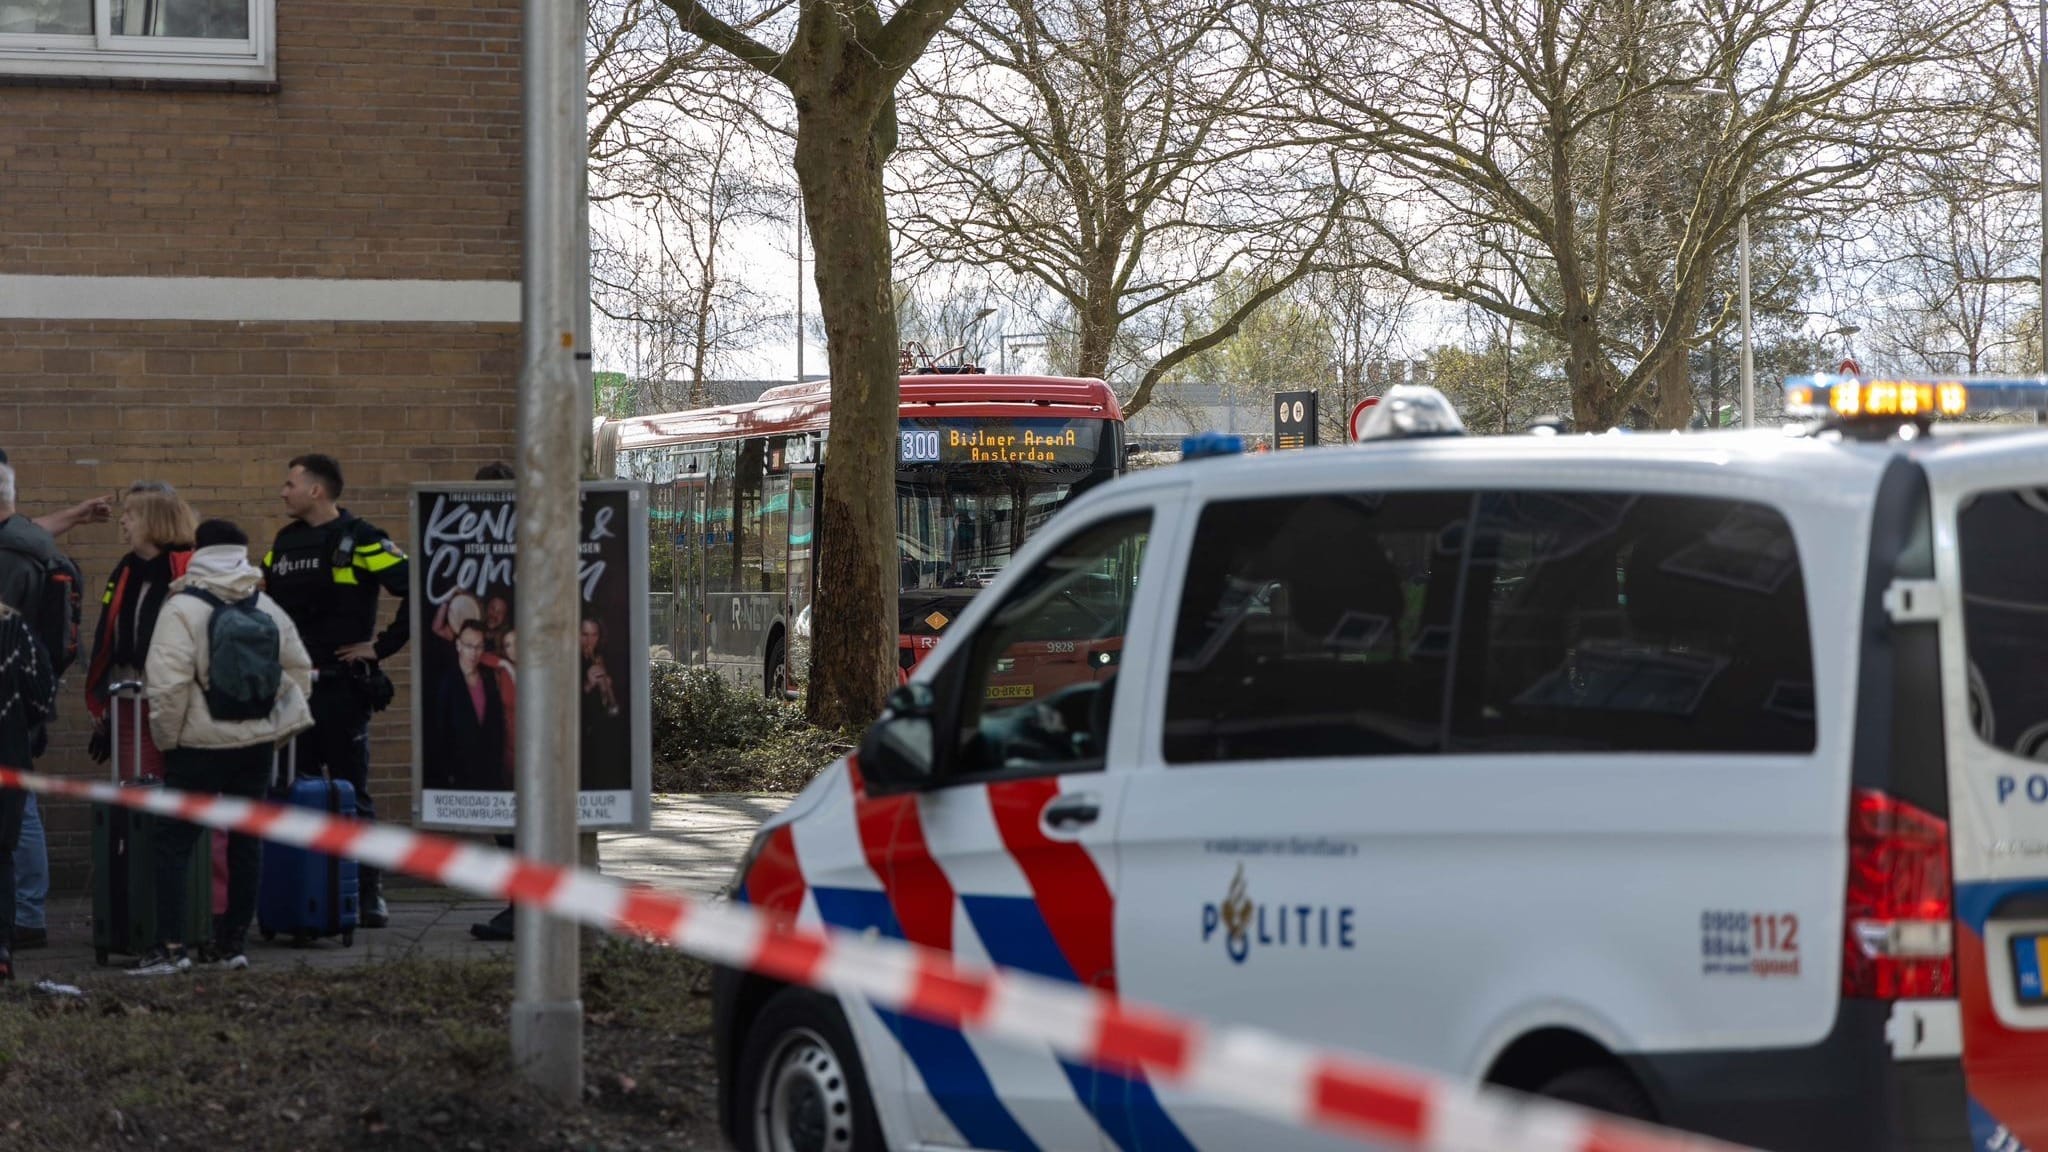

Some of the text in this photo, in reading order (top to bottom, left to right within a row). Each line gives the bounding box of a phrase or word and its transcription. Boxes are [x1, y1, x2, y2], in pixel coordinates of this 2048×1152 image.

[902, 431, 940, 460] 300
[950, 429, 1075, 448] Bijlmer ArenA
[972, 448, 1055, 462] Amsterdam
[589, 506, 616, 540] &
[272, 556, 320, 576] POLITIE
[1047, 641, 1075, 653] 9828
[433, 794, 490, 807] WOENSDAG
[493, 796, 506, 807] 24
[590, 795, 616, 807] UUR
[1202, 903, 1356, 964] POLITIE
[1752, 912, 1800, 952] 112
